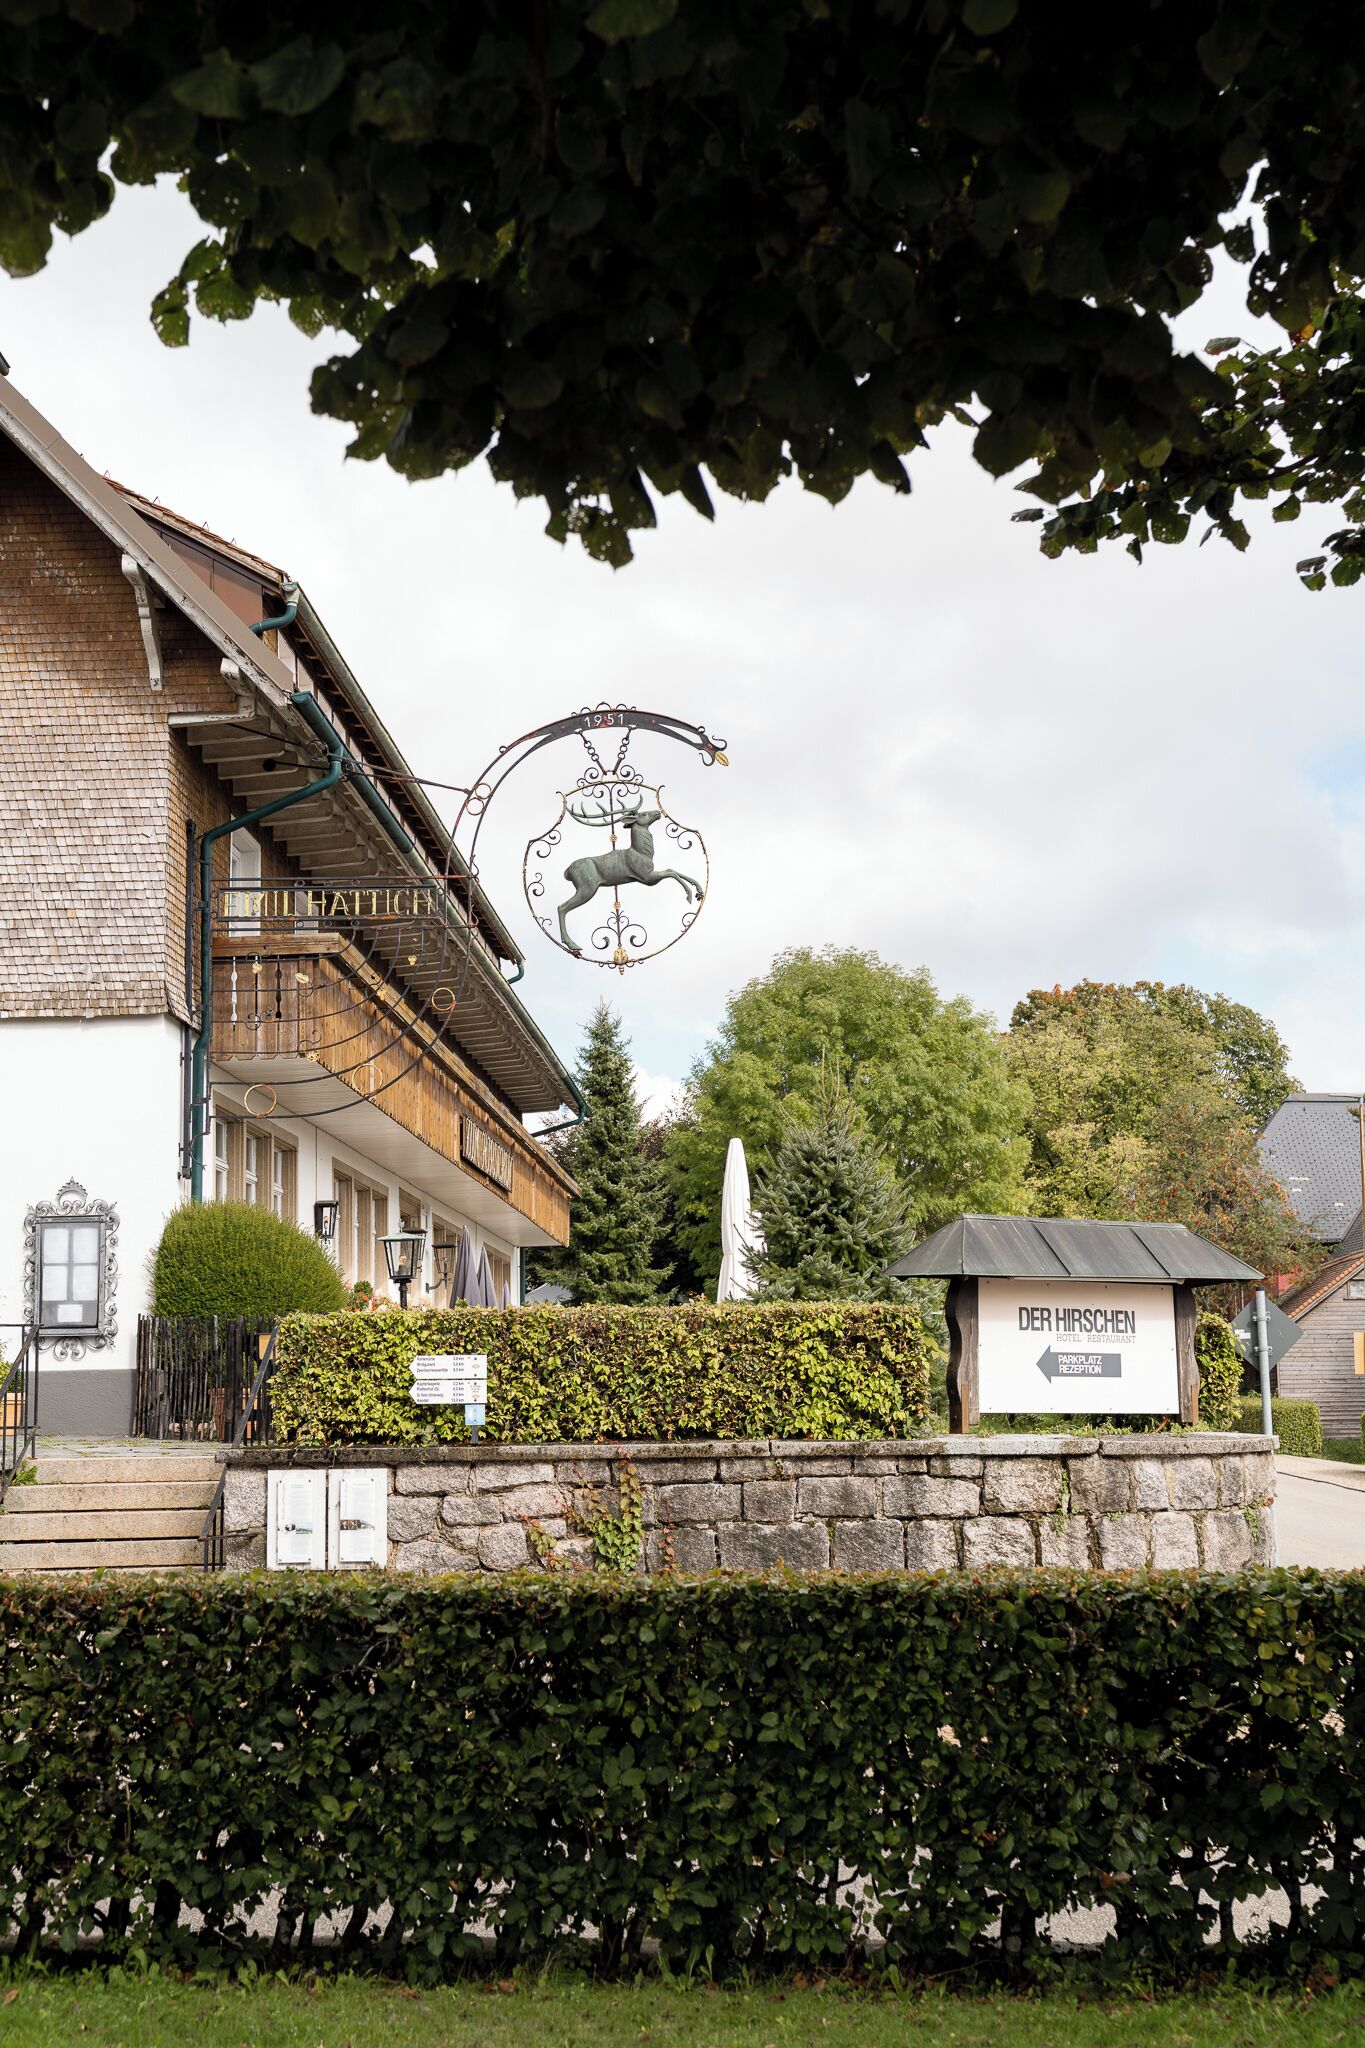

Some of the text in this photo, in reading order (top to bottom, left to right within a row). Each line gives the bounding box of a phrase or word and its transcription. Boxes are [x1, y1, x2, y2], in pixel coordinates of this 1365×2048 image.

[584, 713, 624, 728] 1951
[1018, 1306, 1136, 1334] DER HIRSCHEN
[1056, 1333, 1137, 1344] HOTEL RESTAURANT
[1058, 1354, 1103, 1365] PARKPLATZ
[1059, 1364, 1102, 1374] REZEPTION
